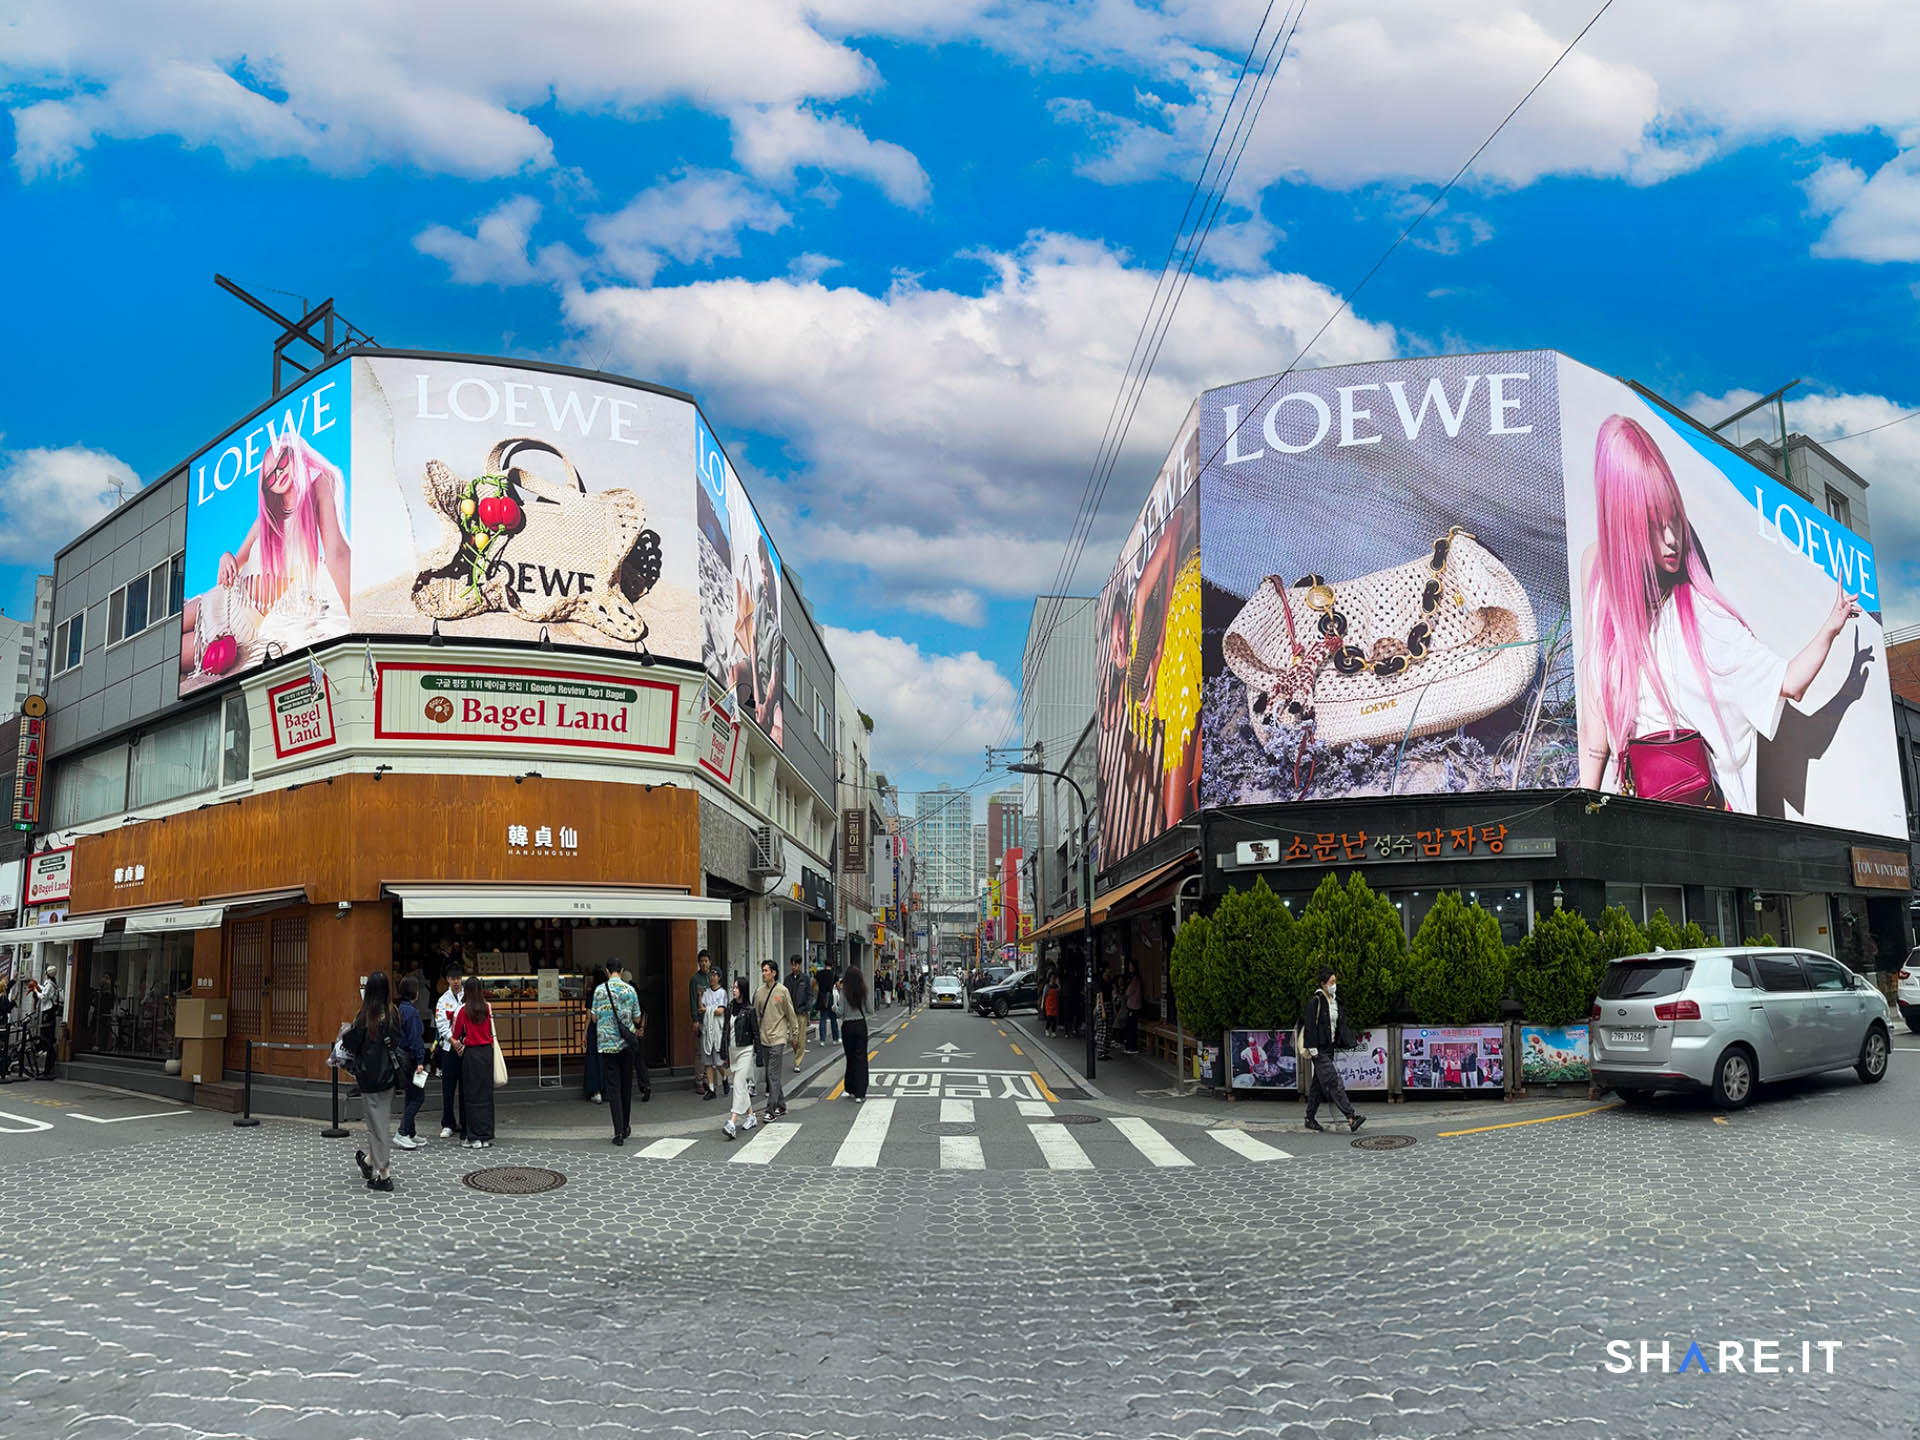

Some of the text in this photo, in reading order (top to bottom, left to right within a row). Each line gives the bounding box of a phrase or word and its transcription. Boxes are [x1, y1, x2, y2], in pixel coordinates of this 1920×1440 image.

[415, 373, 640, 446] LOEWE
[1222, 371, 1534, 466] LOEWE
[197, 381, 337, 507] LOEWE
[1127, 430, 1193, 599] LOEWE
[1754, 485, 1876, 600] LOEWE
[530, 684, 625, 700] Google Review Top1 Bagel
[1360, 698, 1398, 716] LOEWE
[284, 703, 321, 729] Bagel
[288, 721, 322, 745] Land
[461, 698, 546, 732] Bagel
[556, 703, 628, 733] Land
[23, 719, 41, 820] BAGEL
[508, 824, 578, 848] 韓貞仙
[508, 849, 578, 857] HANJUNGSUN
[848, 812, 860, 858] 드림아트
[1284, 831, 1368, 862] 소문난
[1373, 834, 1414, 858] 성수
[1417, 823, 1509, 857] 감자탕
[1874, 863, 1908, 878] VINTAGE
